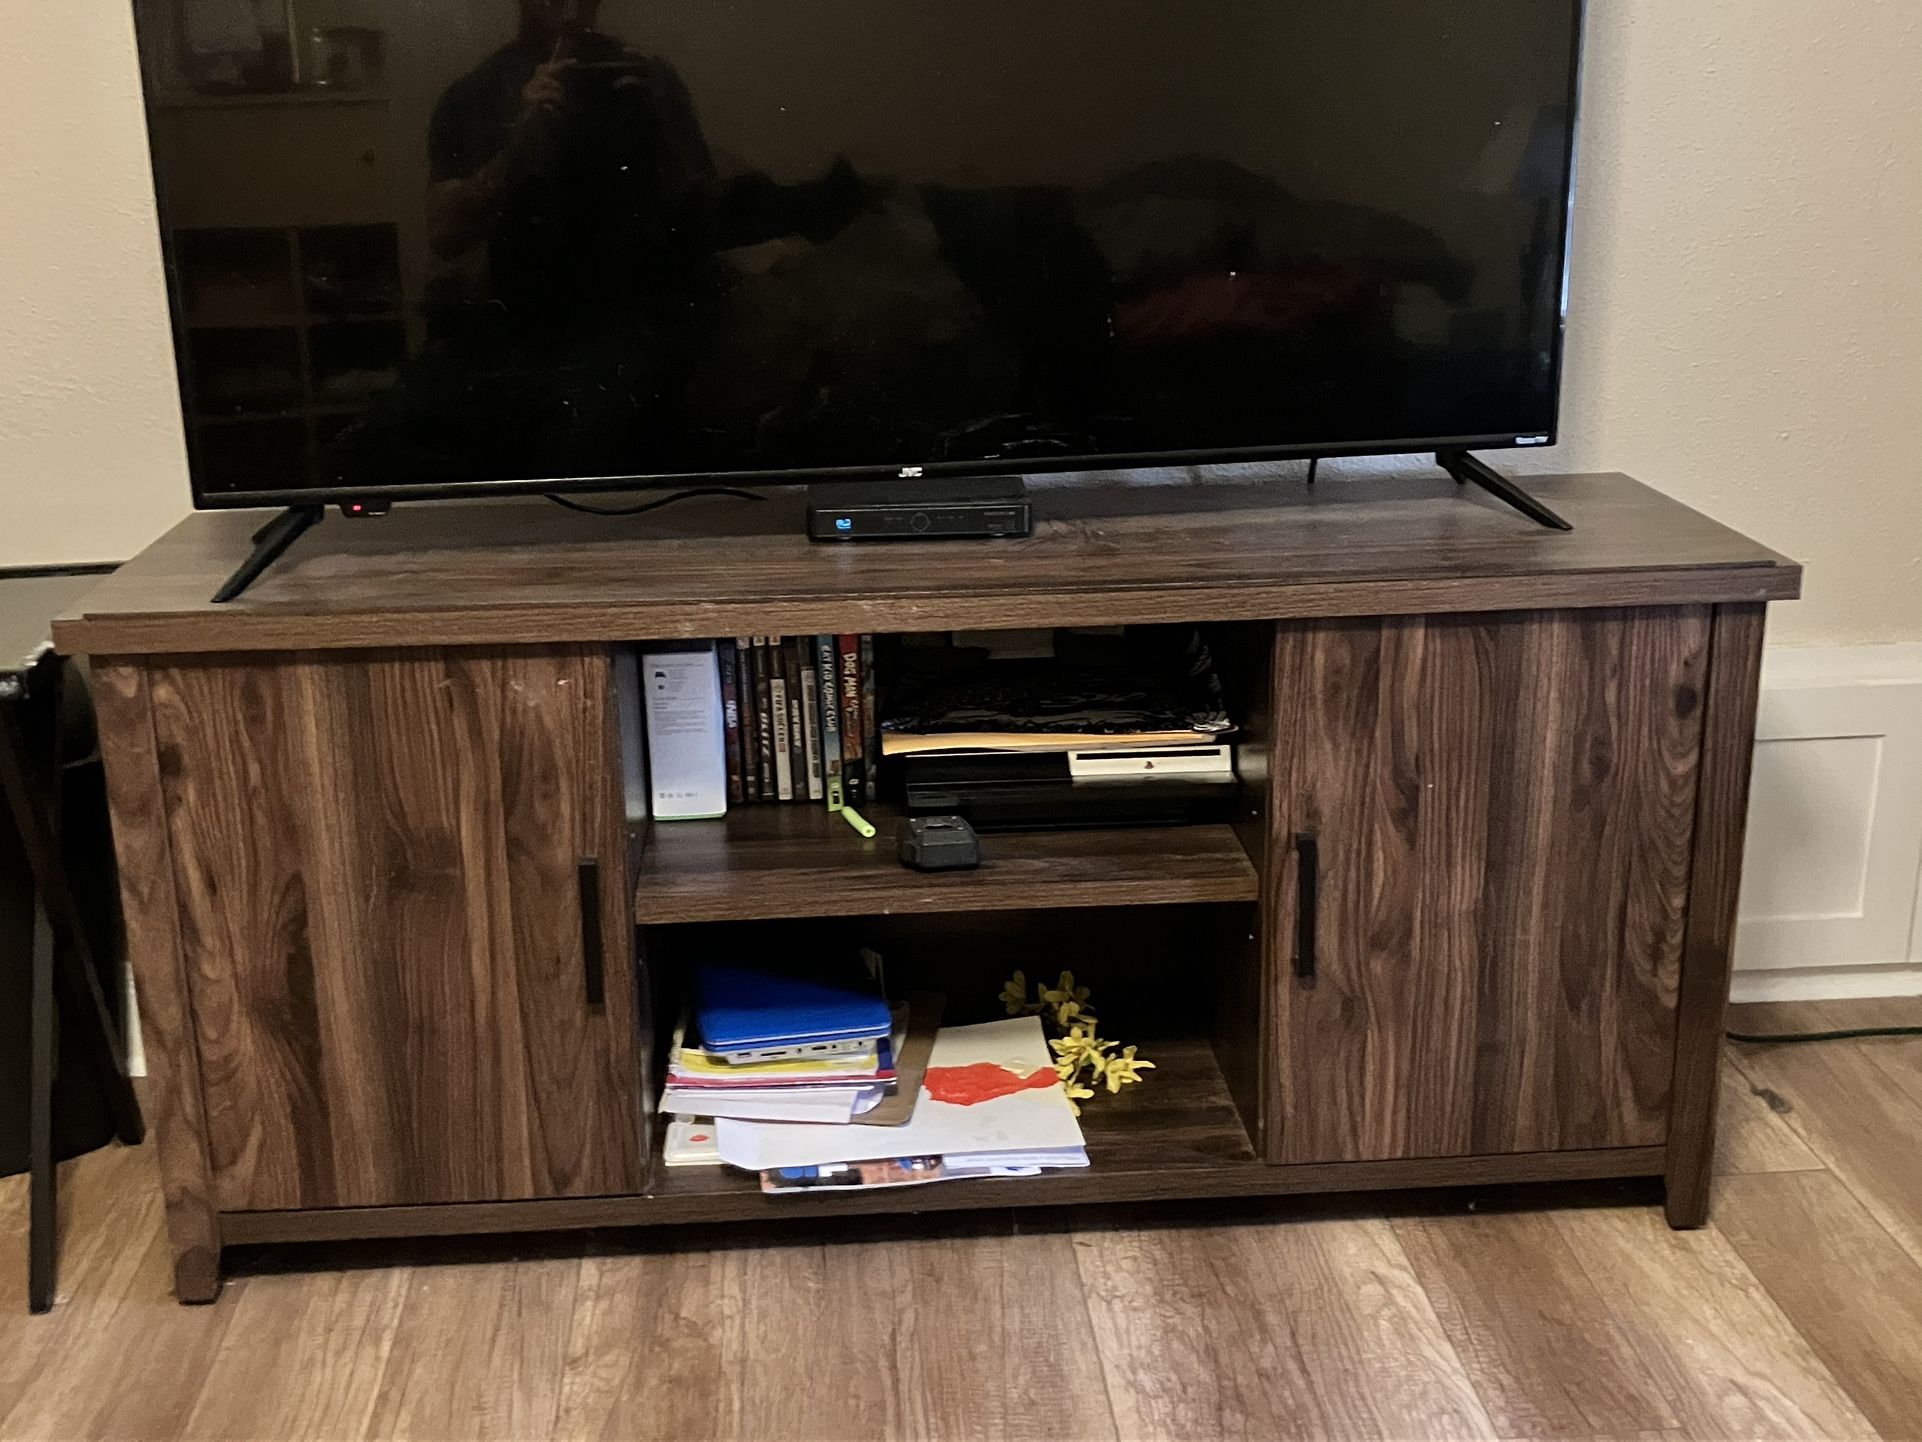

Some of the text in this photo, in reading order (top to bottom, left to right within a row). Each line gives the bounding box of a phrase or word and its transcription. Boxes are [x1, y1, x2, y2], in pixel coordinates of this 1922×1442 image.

[842, 653, 858, 675] DOG
[821, 645, 836, 732] CAT KID COMIC CLUB
[843, 676, 858, 698] MAN
